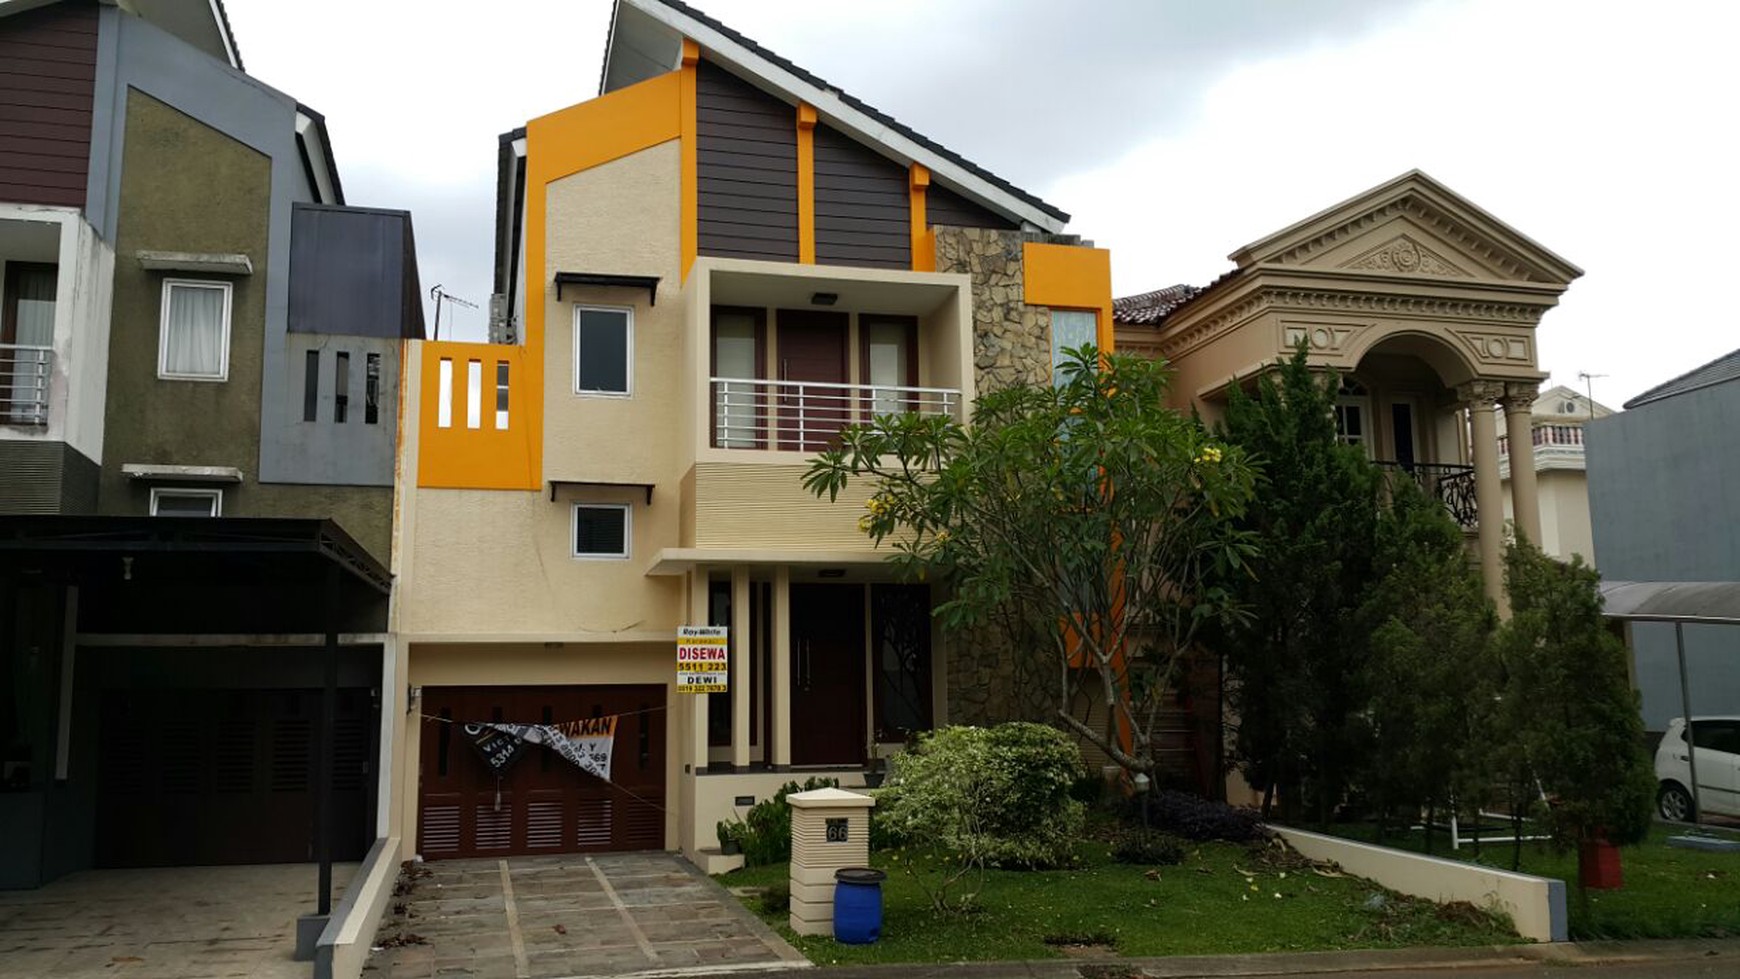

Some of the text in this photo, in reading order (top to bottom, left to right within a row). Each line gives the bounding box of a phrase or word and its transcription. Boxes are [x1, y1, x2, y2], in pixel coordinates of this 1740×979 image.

[679, 647, 726, 660] DISEWA
[678, 662, 727, 671] 5511 223
[687, 676, 717, 684] DEWI
[828, 826, 848, 840] 66
